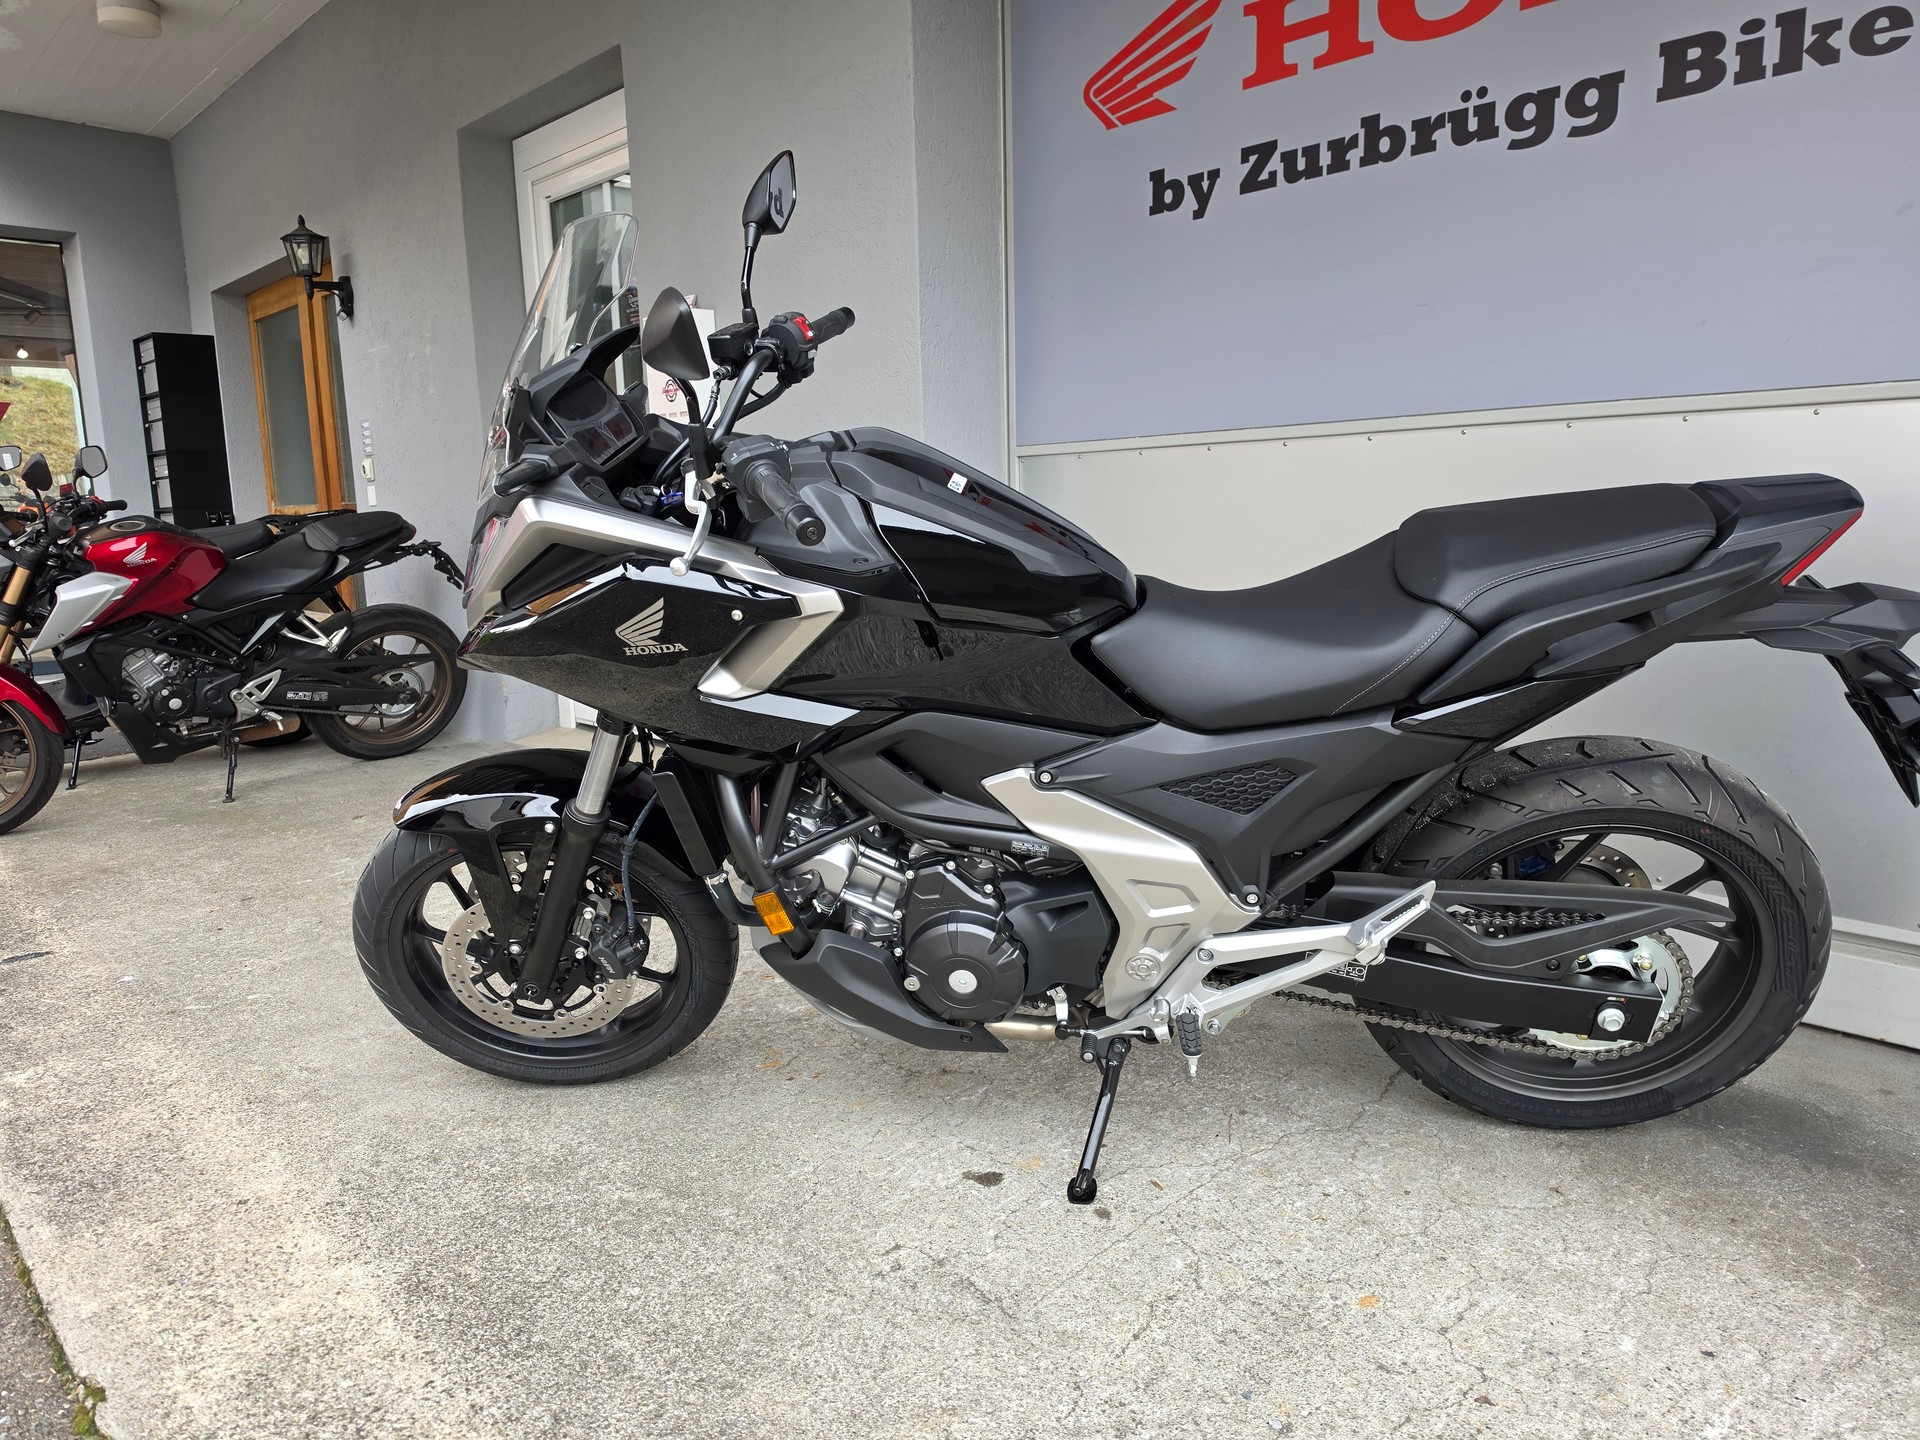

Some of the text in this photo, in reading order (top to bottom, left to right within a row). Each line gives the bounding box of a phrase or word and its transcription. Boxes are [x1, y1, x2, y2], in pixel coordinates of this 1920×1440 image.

[1149, 5, 1914, 220] by Zurbrügg Bike
[623, 643, 689, 656] HONDA
